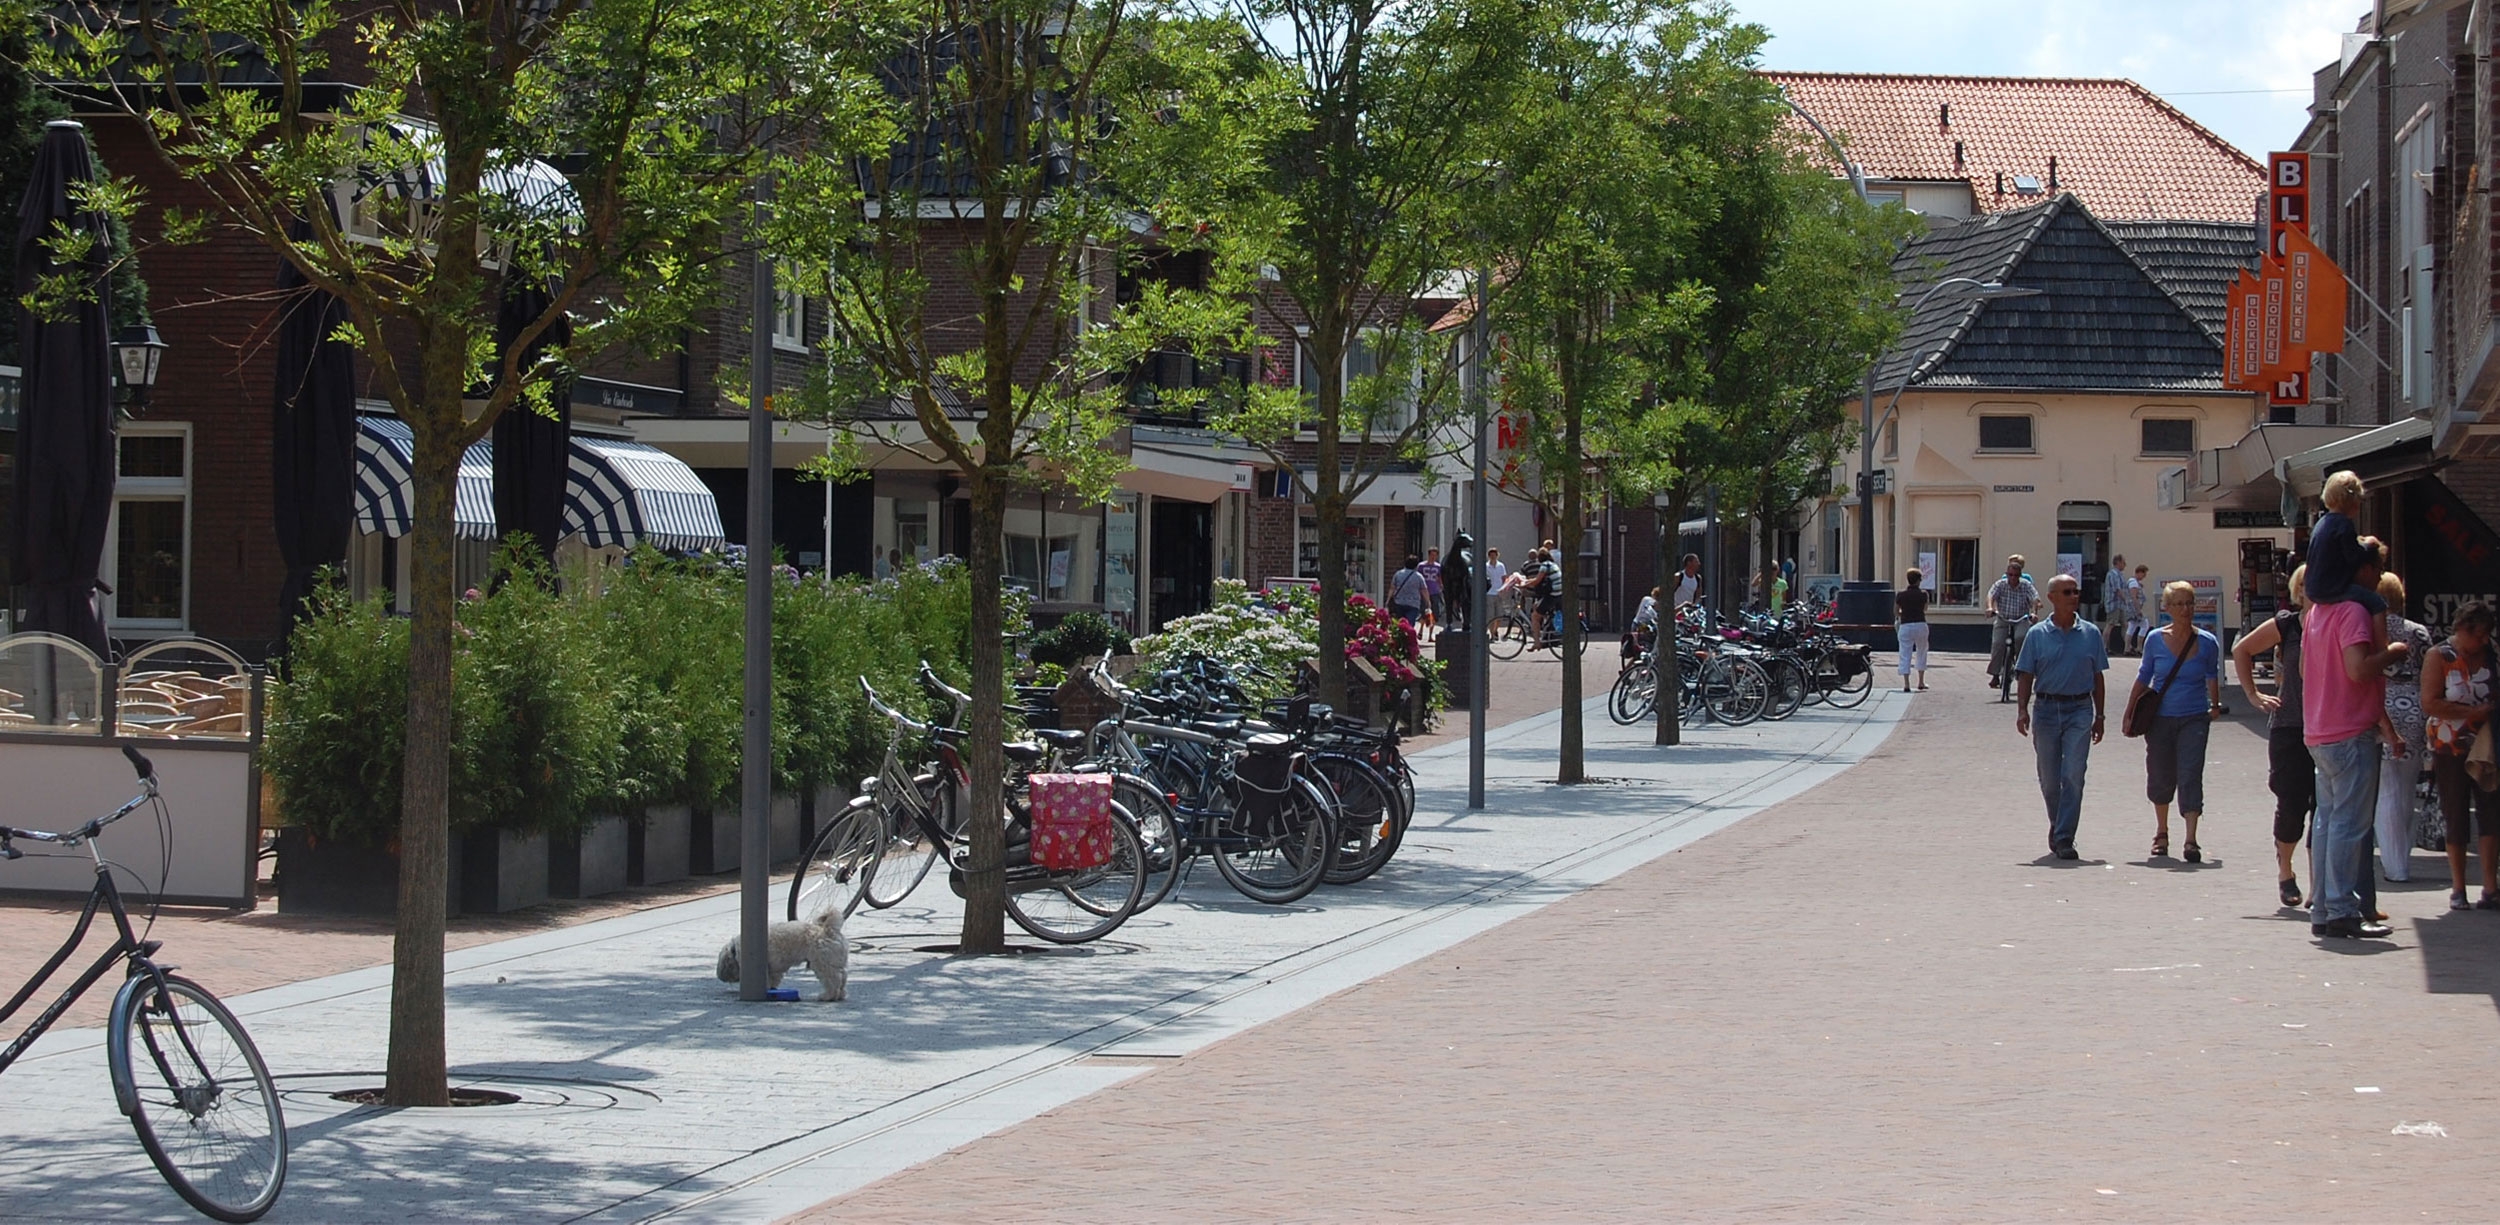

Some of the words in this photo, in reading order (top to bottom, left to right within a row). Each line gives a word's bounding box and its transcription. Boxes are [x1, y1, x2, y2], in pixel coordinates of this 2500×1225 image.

[2246, 295, 2259, 373] BLOKKER
[2266, 279, 2281, 362] BLOKKER
[2292, 254, 2307, 341] BLOKKER
[2425, 504, 2488, 565] SALE
[1423, 567, 1439, 581] 52
